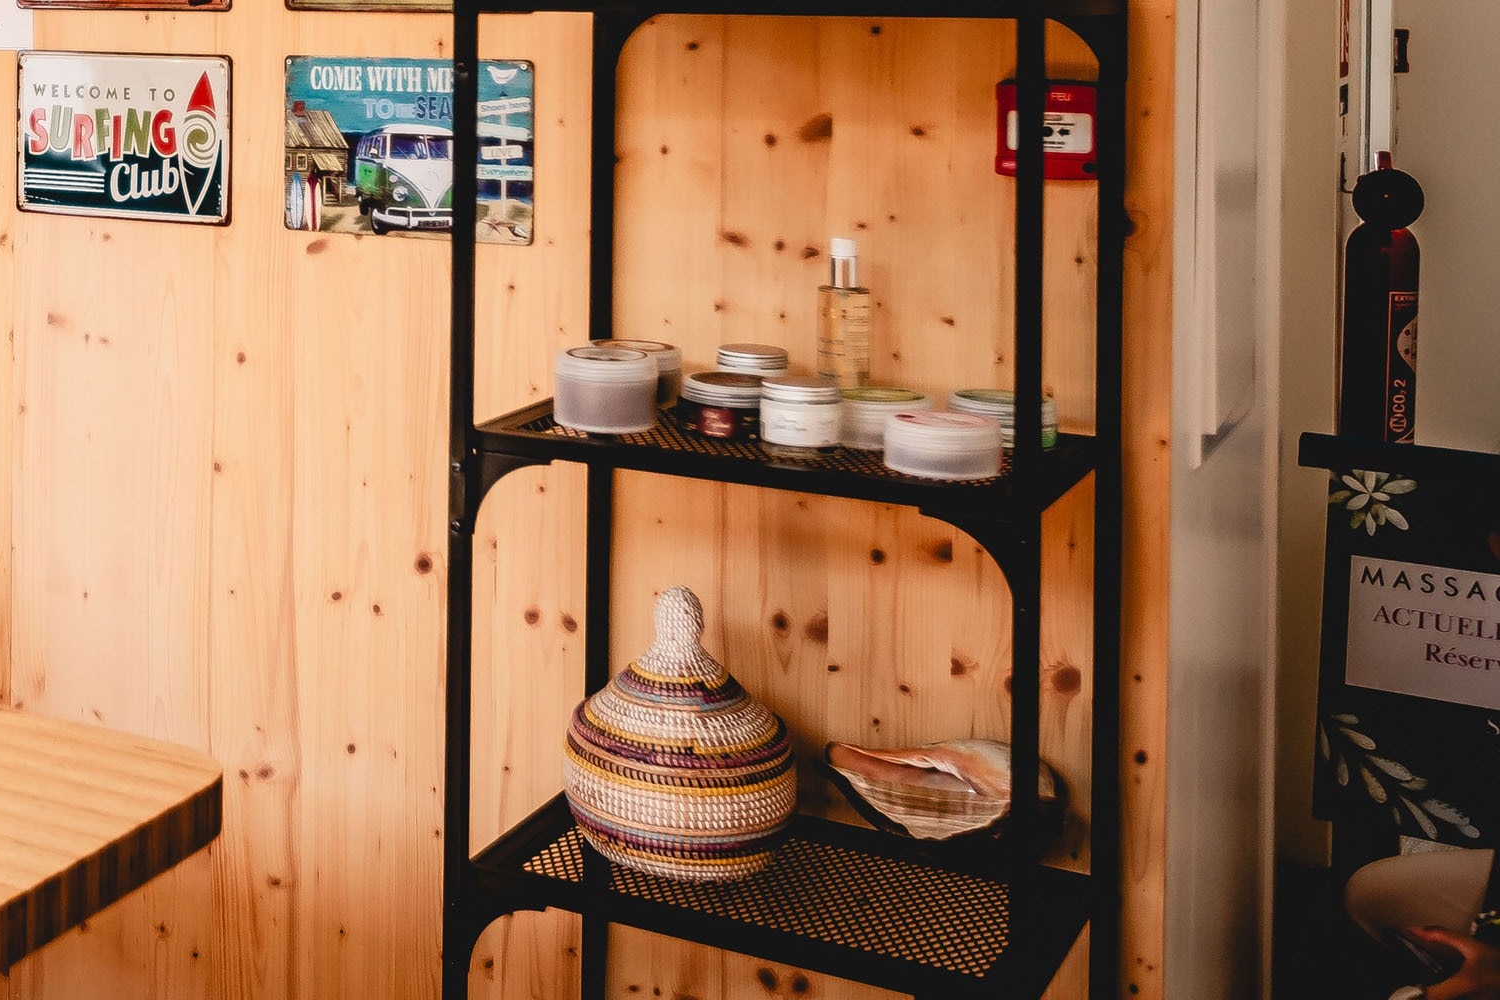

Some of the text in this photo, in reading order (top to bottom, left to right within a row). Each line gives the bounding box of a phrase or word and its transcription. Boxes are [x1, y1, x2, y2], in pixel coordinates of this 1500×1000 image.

[33, 83, 176, 102] WELCOME TO
[310, 65, 362, 91] COME
[366, 66, 422, 93] WITH
[363, 98, 394, 119] TO
[415, 95, 453, 121] SEA
[29, 104, 178, 161] SURFING
[109, 159, 180, 202] Club
